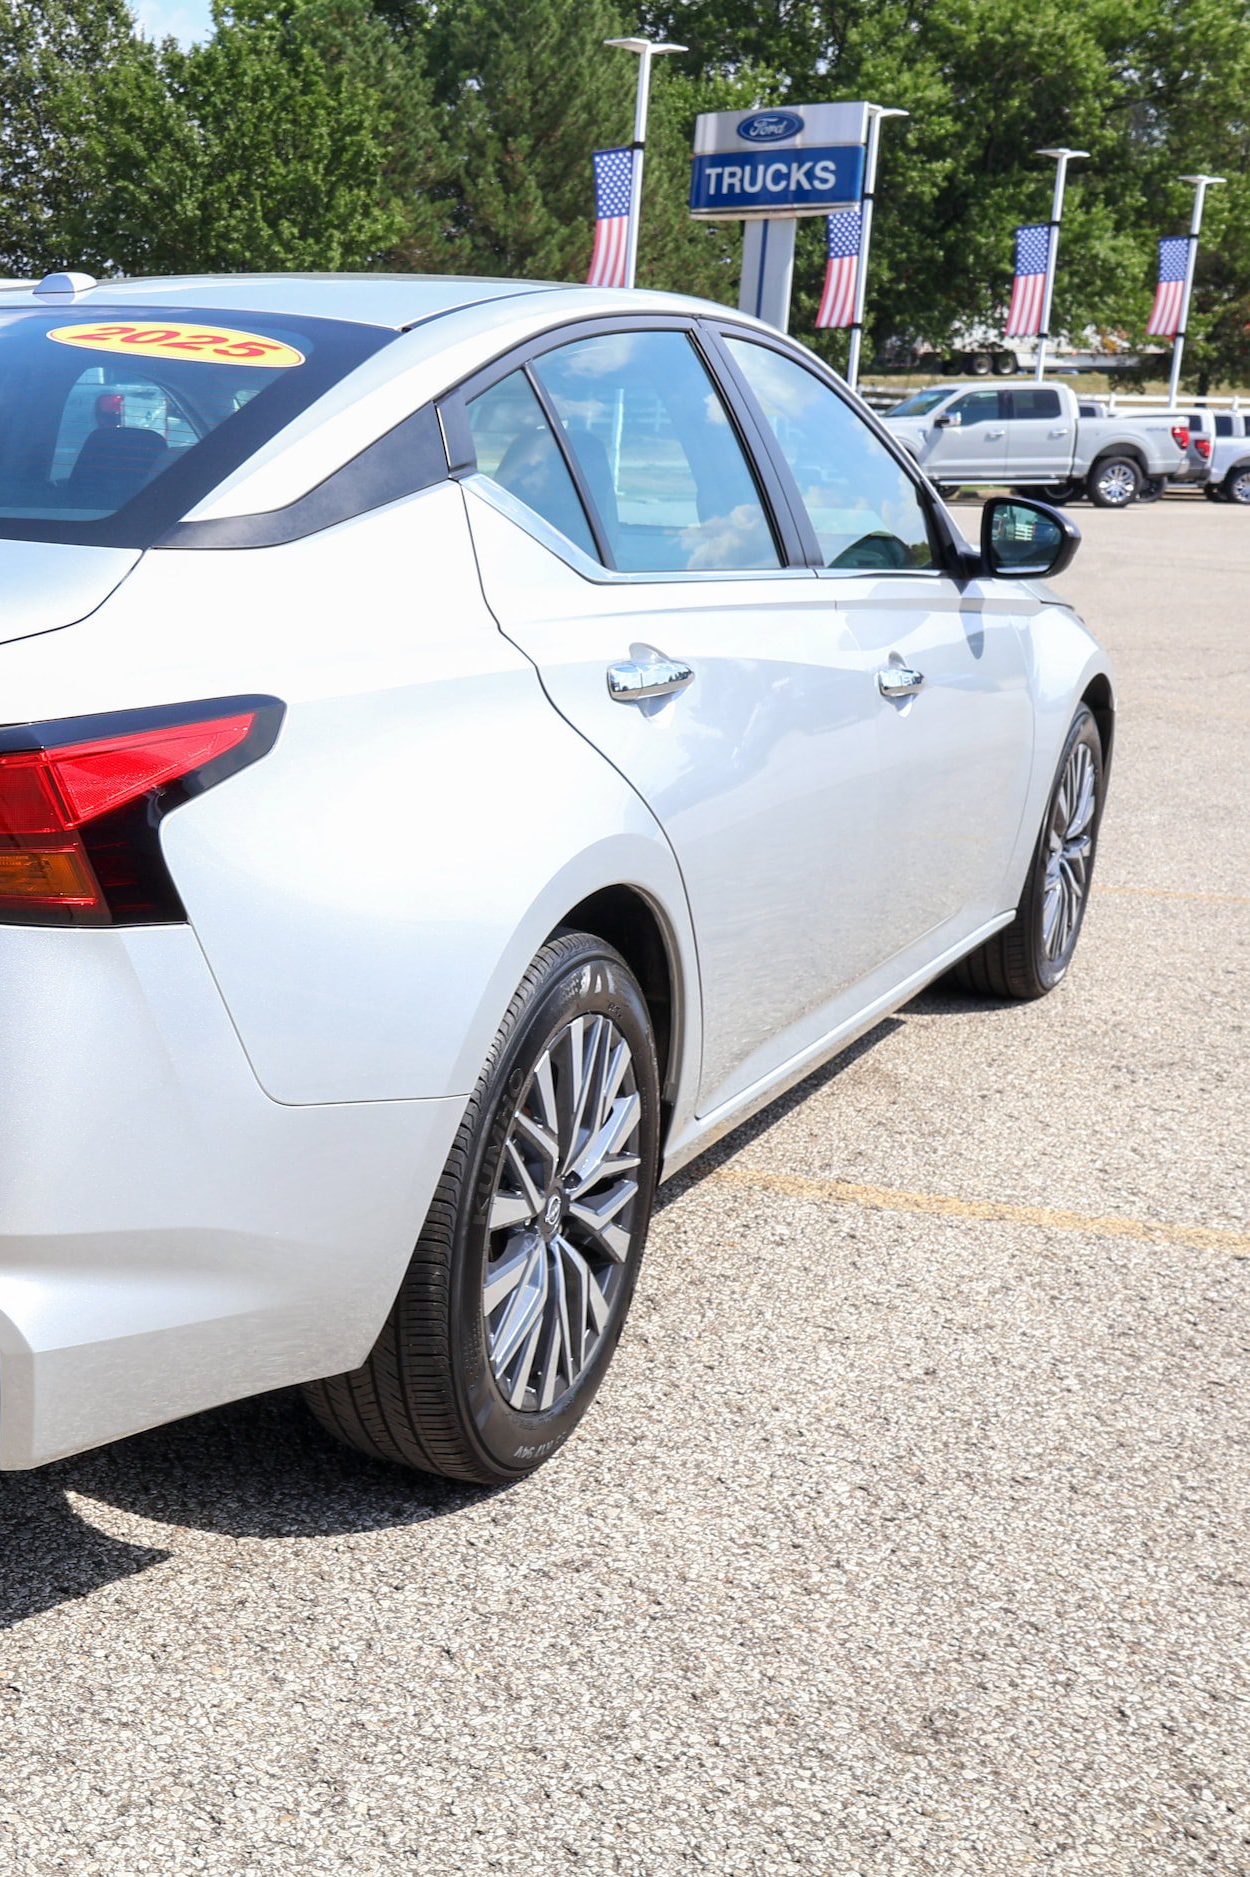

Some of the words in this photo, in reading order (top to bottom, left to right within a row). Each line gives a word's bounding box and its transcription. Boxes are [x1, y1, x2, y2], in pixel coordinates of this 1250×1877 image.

[750, 117, 788, 137] Ford
[705, 160, 837, 195] TRUCKS
[68, 326, 282, 357] 2025
